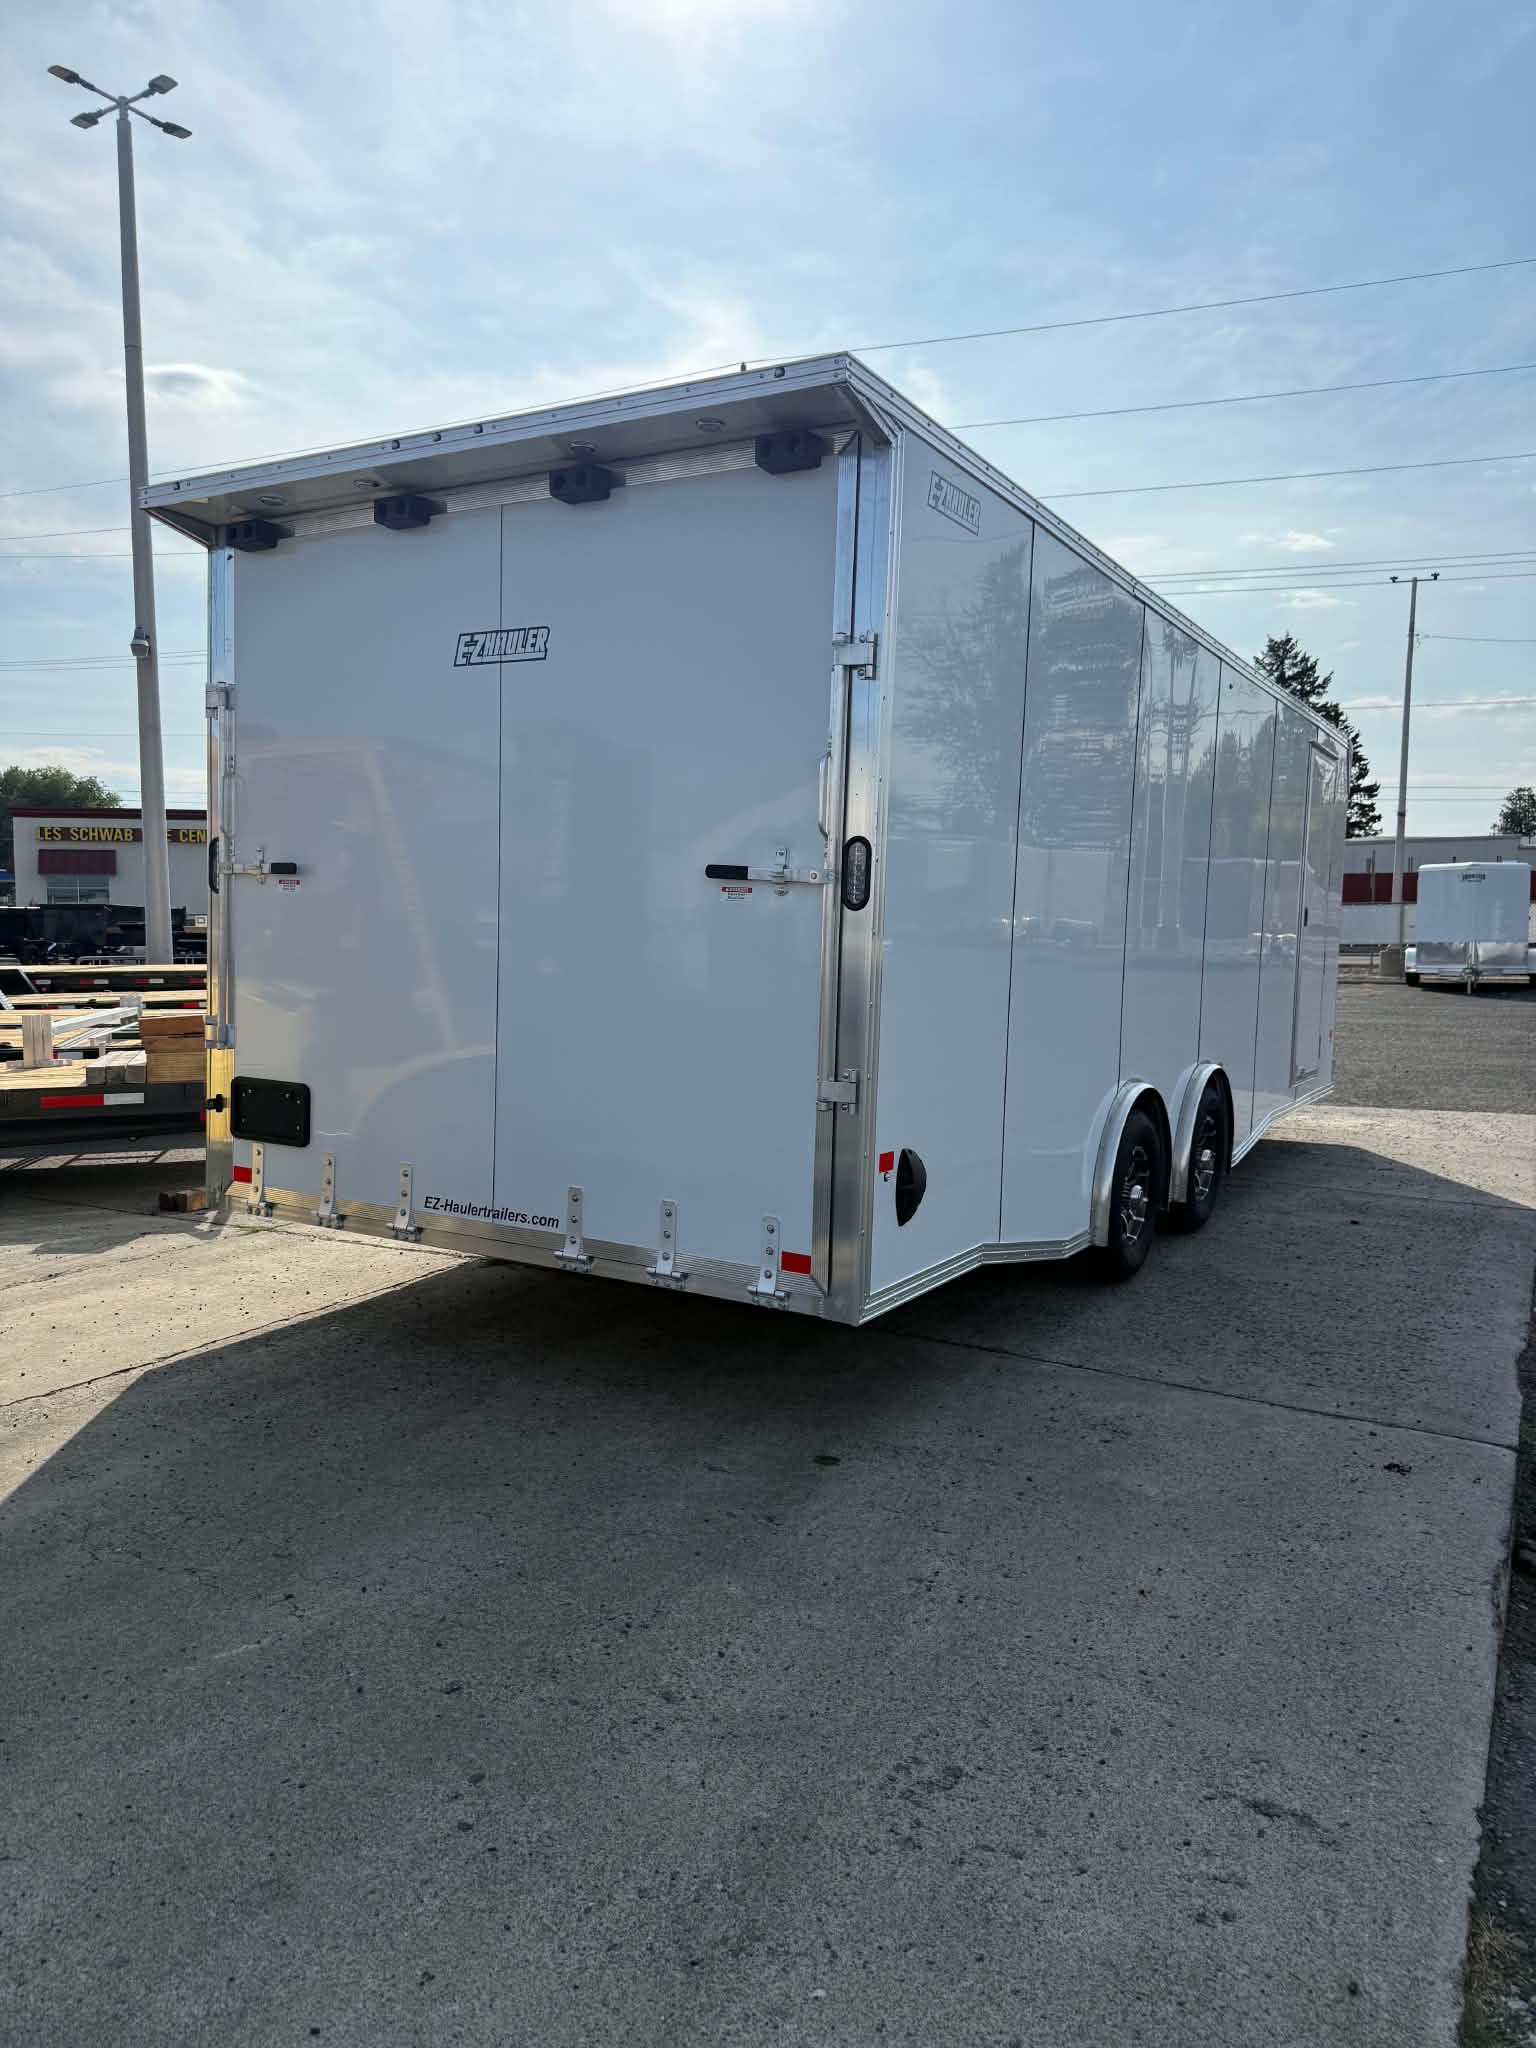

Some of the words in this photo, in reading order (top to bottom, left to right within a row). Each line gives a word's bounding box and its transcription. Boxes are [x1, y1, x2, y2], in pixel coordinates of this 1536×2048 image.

[36, 827, 62, 841] LES
[70, 828, 134, 841] SCHWAB
[179, 829, 207, 843] CEN
[424, 1196, 560, 1228] EZ-Haulertrailers.com
